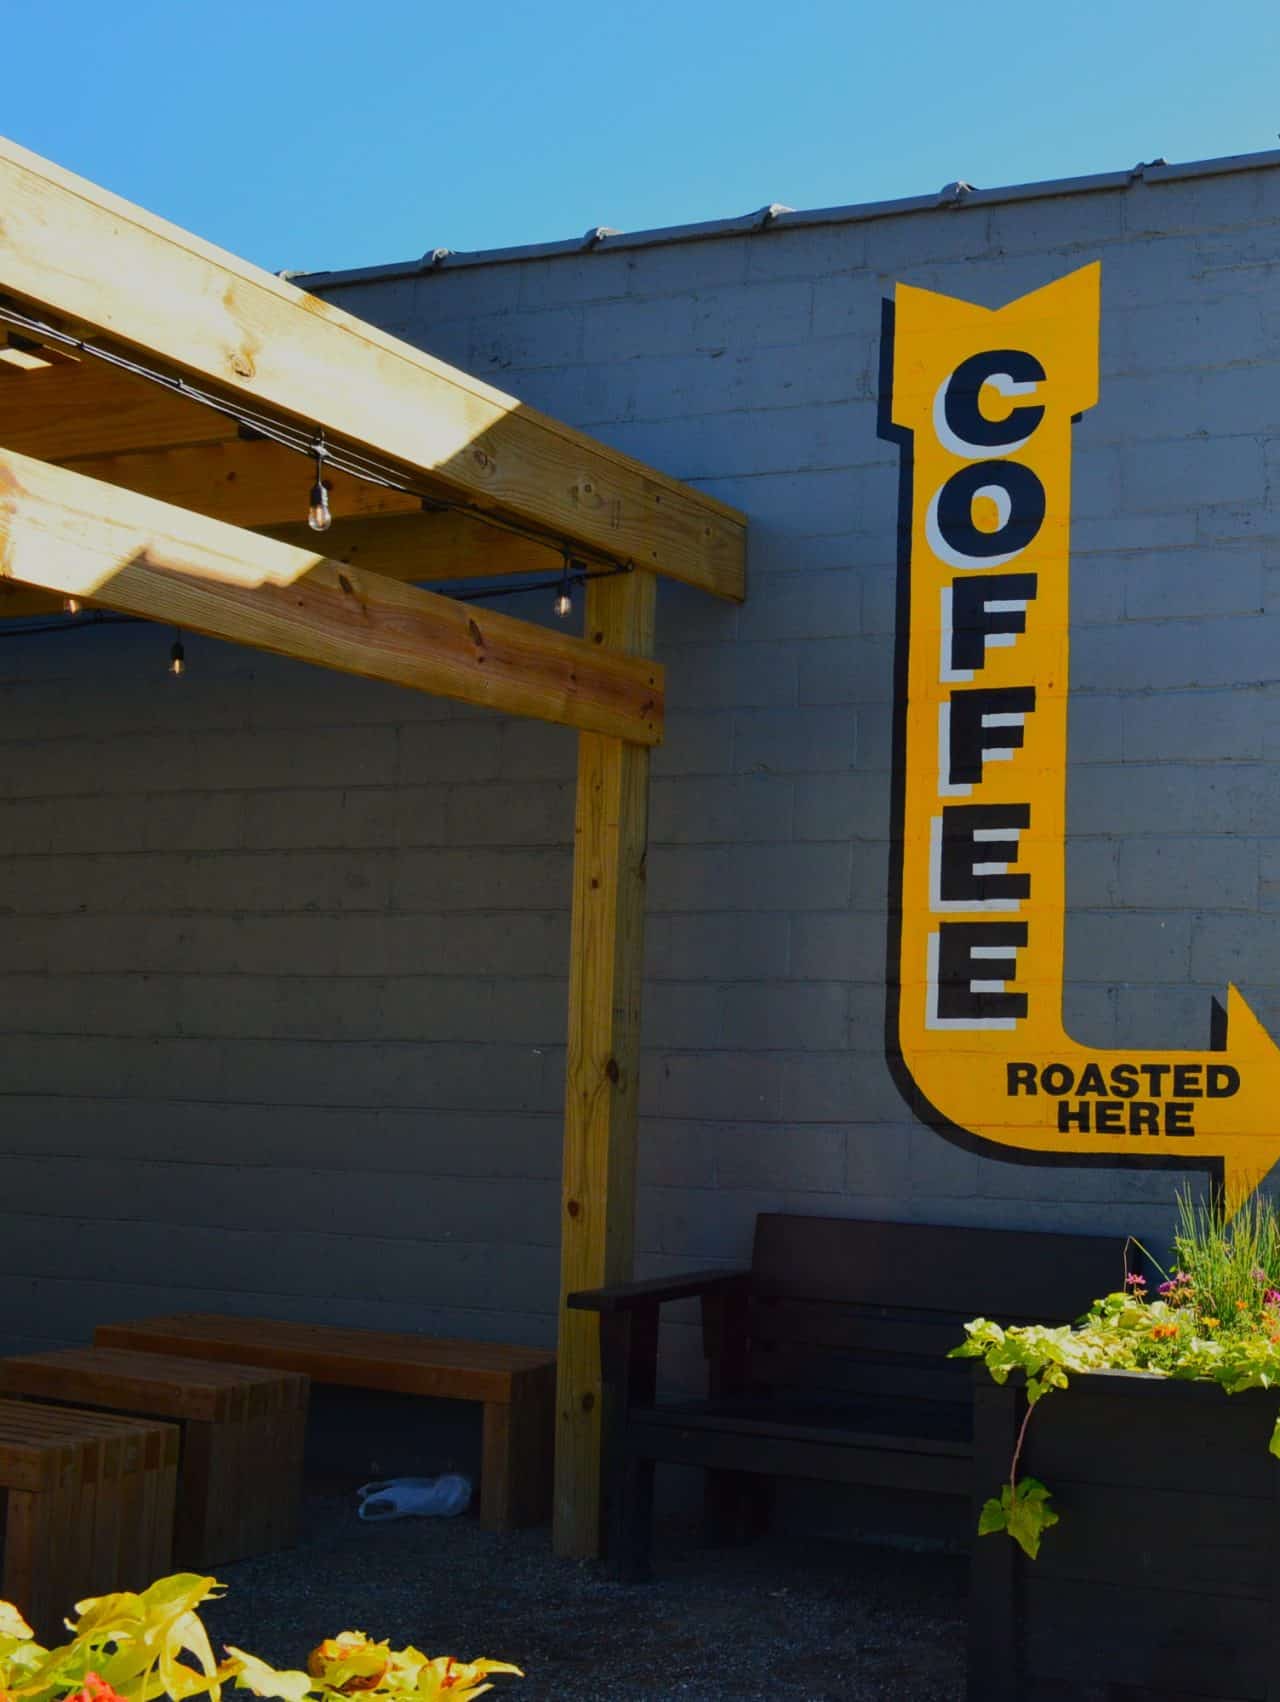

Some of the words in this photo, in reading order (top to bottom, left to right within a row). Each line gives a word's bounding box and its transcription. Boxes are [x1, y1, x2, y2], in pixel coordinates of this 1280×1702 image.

[925, 349, 1047, 1030] COFFEE
[1006, 1062, 1241, 1098] ROASTED
[1057, 1101, 1195, 1136] HERE
